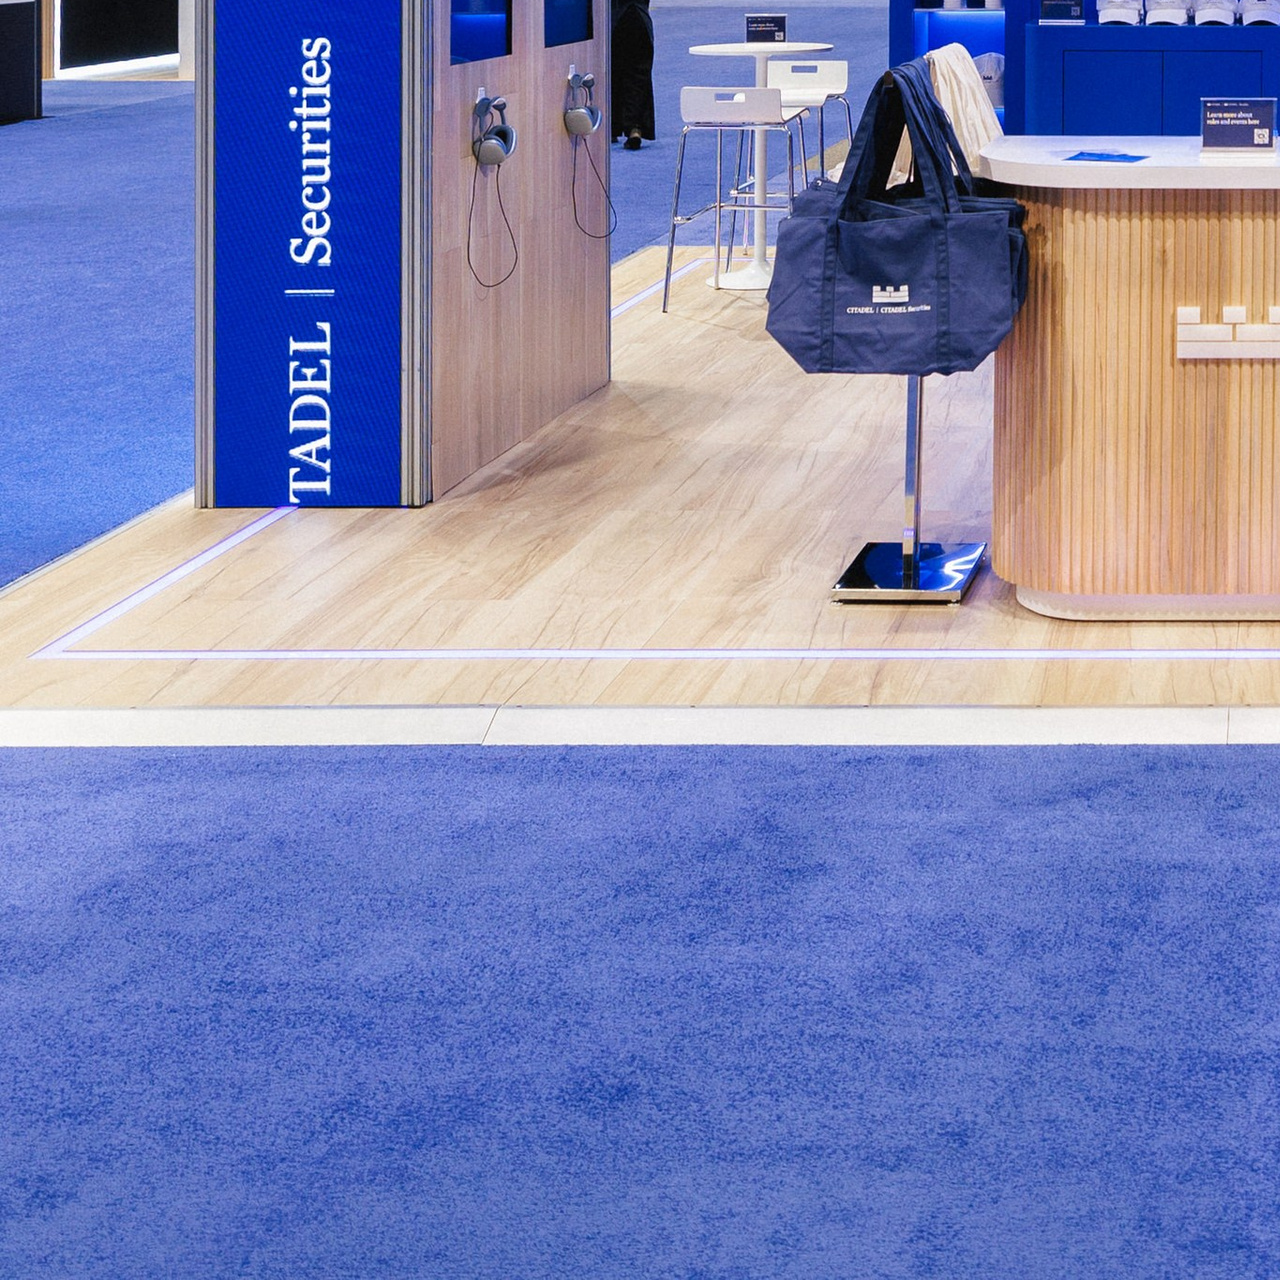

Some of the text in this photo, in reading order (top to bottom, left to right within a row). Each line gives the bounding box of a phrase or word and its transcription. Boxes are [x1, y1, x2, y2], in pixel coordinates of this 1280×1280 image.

[288, 36, 333, 267] Securities
[846, 306, 875, 315] CITADEL
[880, 305, 907, 314] CITADEL
